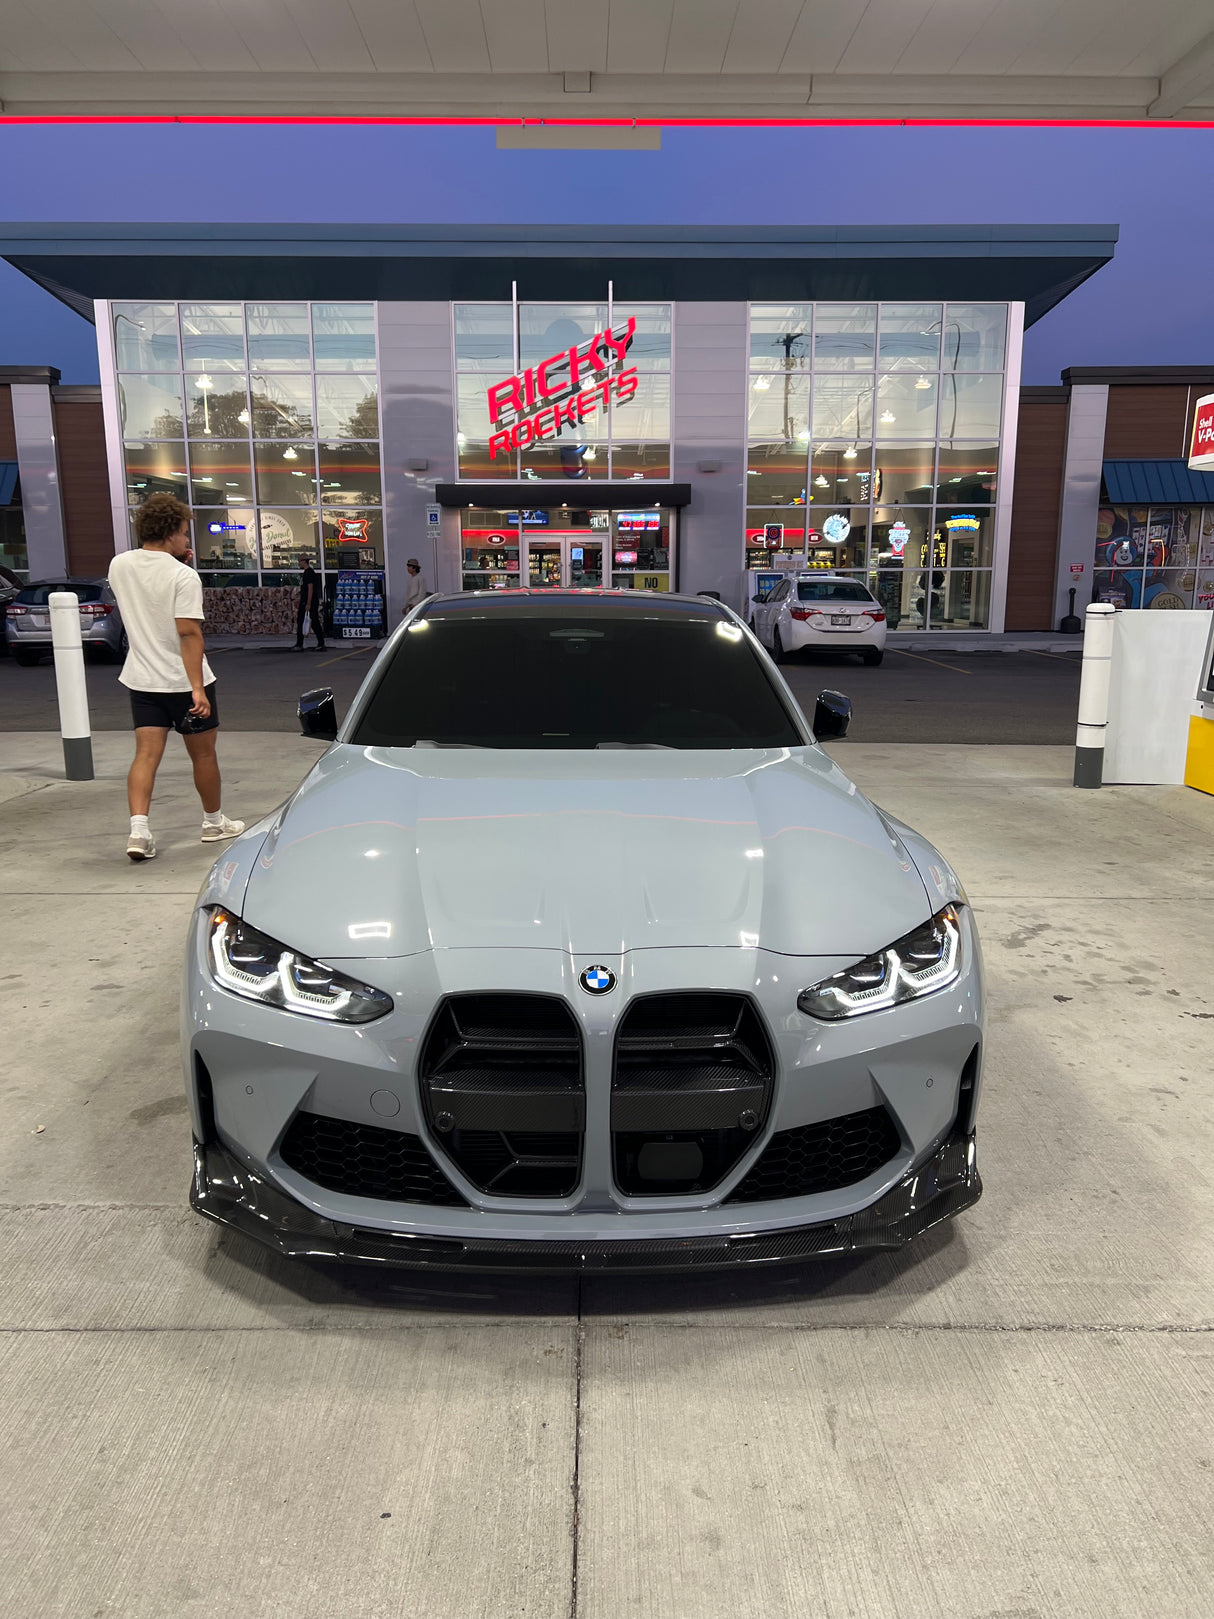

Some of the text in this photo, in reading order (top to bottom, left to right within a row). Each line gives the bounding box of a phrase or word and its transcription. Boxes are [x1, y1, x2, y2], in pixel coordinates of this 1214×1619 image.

[487, 315, 636, 424] RICKY
[488, 366, 639, 460] ROCKETS
[1199, 416, 1213, 429] Shell
[644, 577, 658, 588] NO
